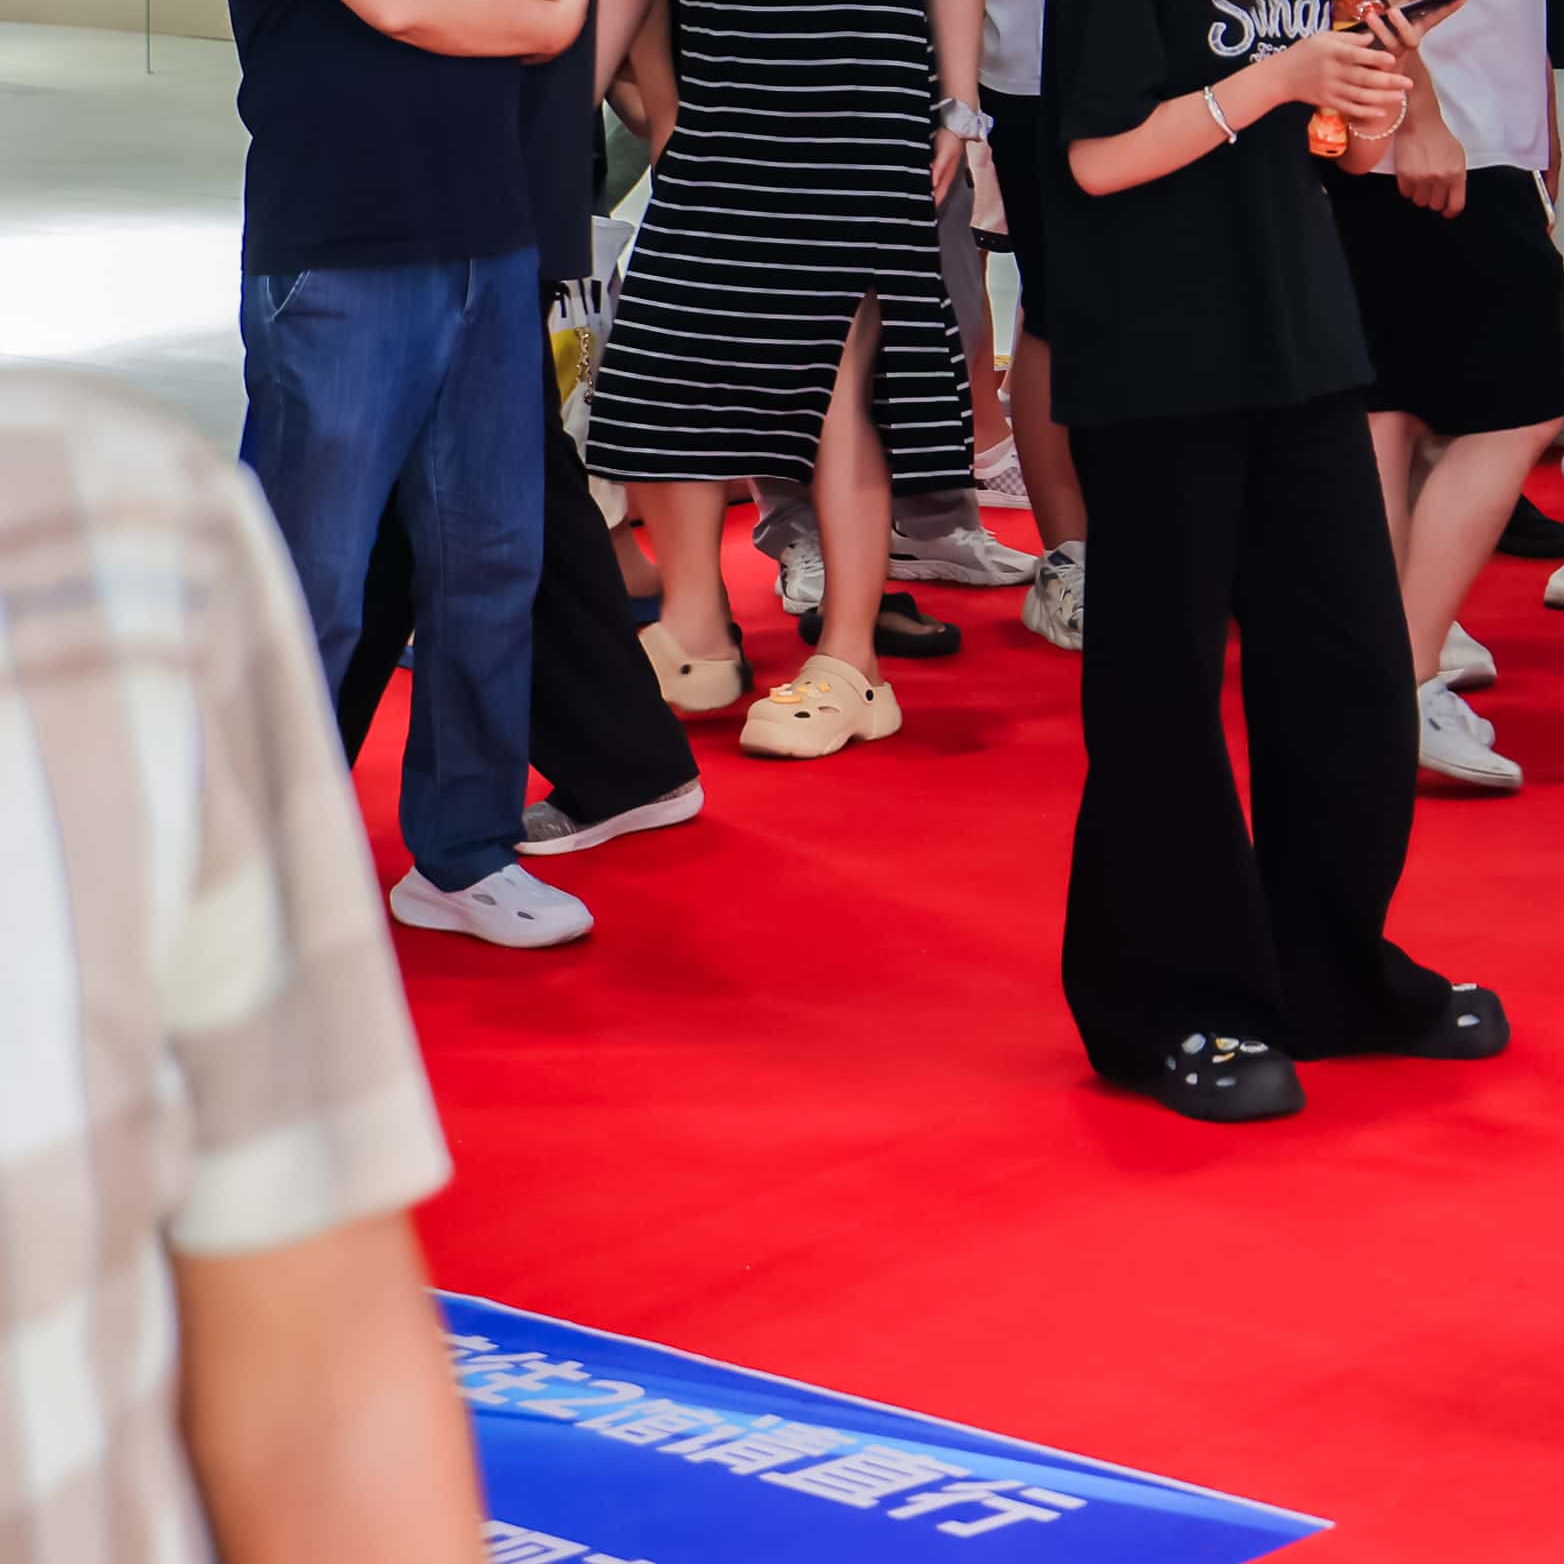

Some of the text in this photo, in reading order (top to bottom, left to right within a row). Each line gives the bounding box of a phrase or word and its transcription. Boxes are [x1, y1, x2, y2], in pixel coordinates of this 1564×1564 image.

[448, 1332, 1088, 1537] 往2馆请直行
